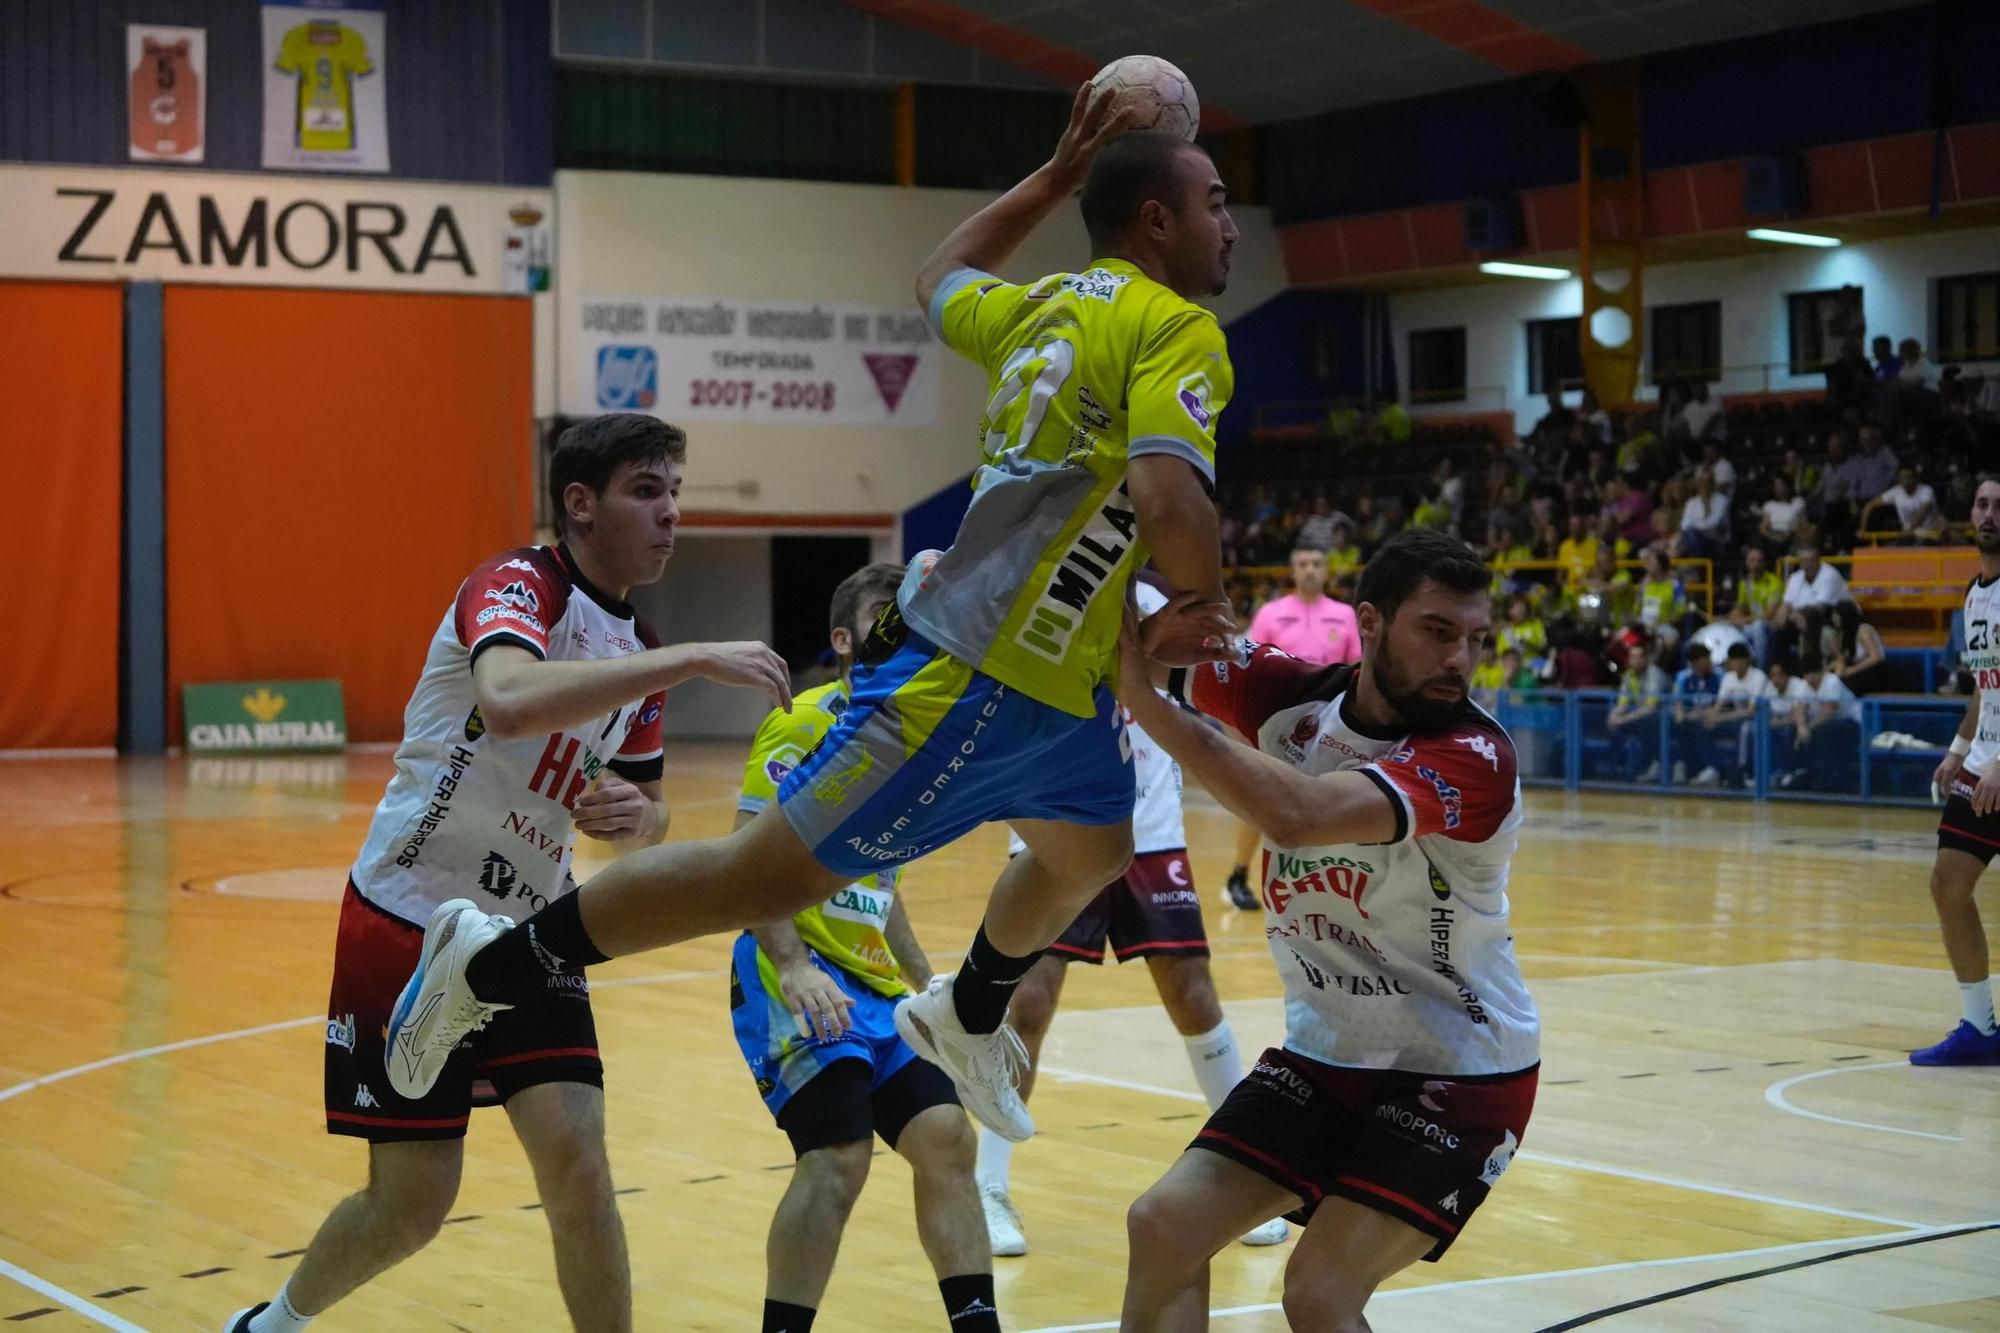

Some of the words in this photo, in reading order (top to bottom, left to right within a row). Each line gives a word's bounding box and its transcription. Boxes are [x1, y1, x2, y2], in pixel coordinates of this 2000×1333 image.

[316, 56, 332, 91] 9
[56, 188, 477, 277] ZAMORA
[711, 351, 816, 371] TEMPORADA
[689, 379, 837, 412] 2007-2008
[1048, 479, 1136, 613] MILA
[1968, 619, 1989, 651] 23
[254, 721, 345, 746] RURAL
[434, 745, 474, 802] HIPER
[396, 799, 450, 869] HIERROS
[830, 889, 879, 916] CAJA
[1430, 907, 1454, 962] HIPER
[1376, 1103, 1460, 1151] INNOPORC
